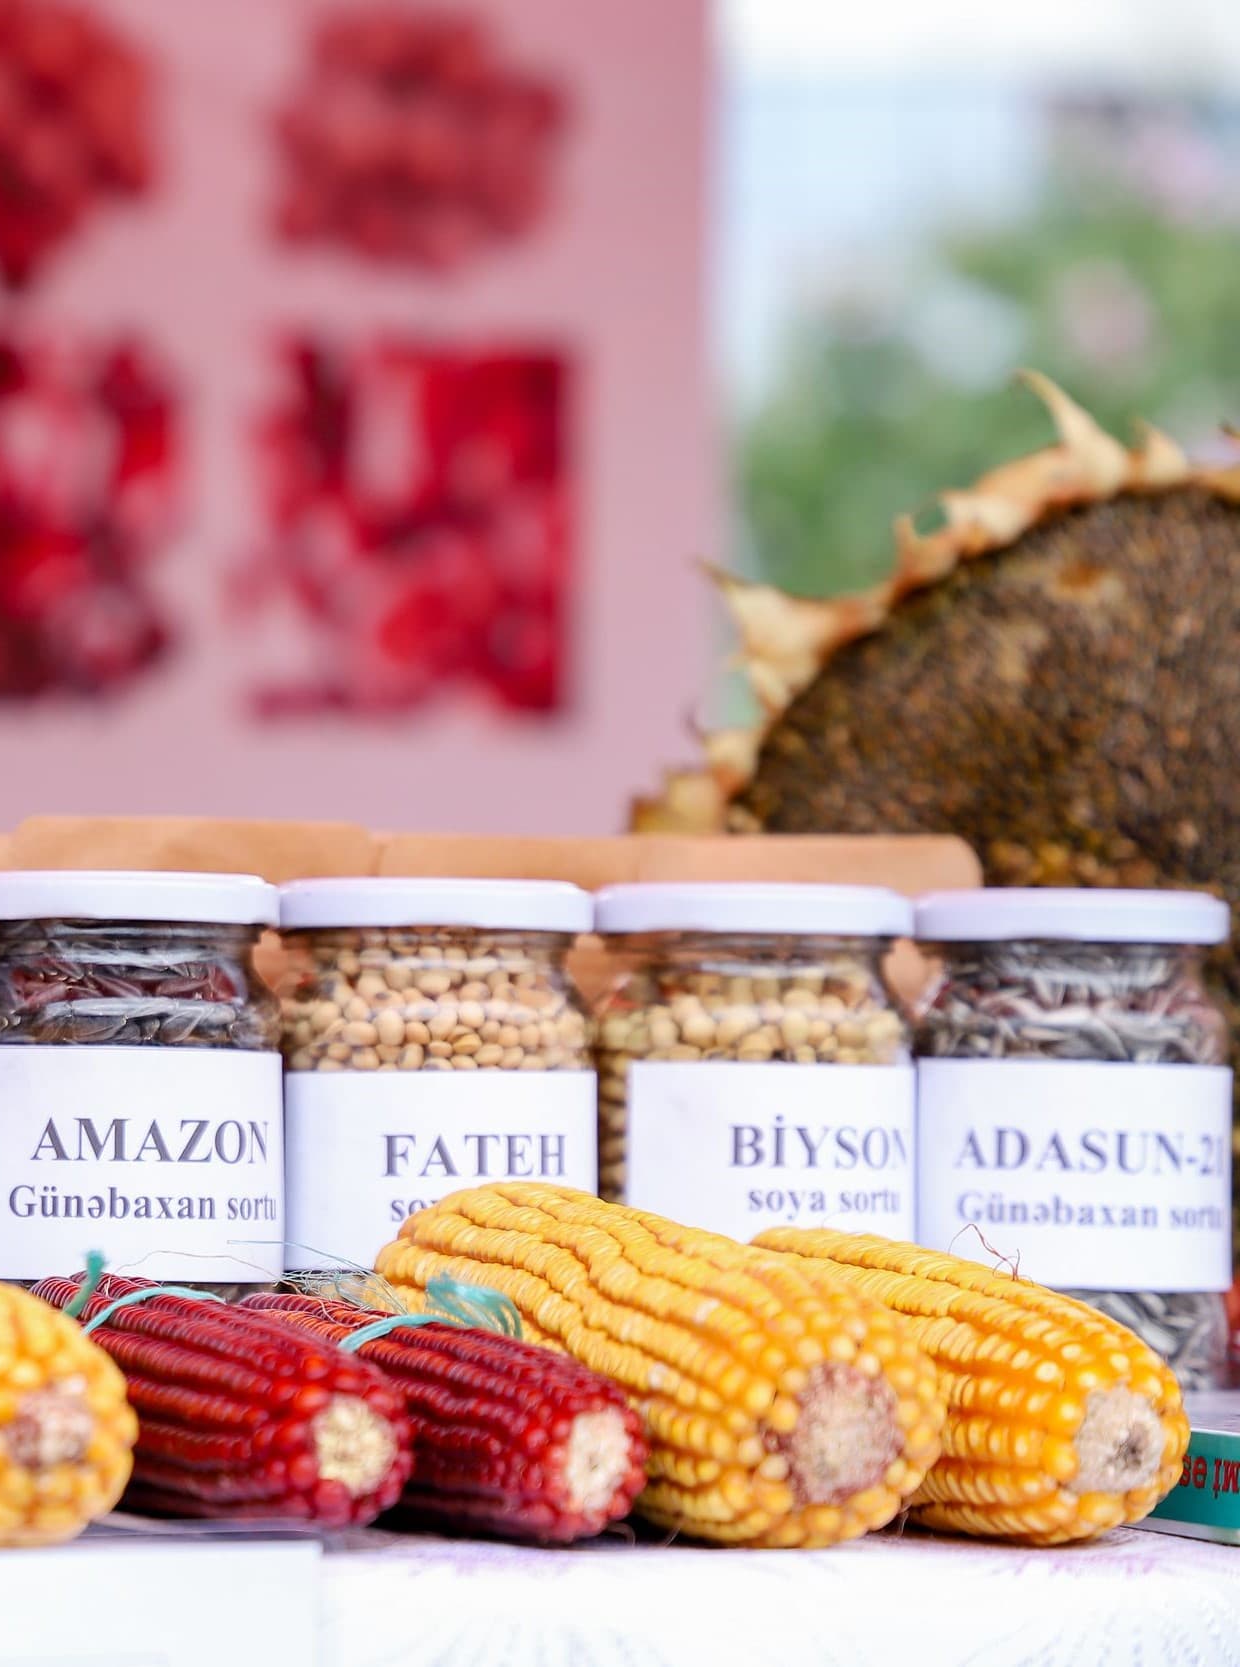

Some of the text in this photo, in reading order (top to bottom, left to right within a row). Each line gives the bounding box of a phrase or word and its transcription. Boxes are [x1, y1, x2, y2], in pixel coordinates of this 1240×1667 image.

[29, 1116, 269, 1165] AMAZON
[381, 1133, 568, 1178] FATEH
[9, 1184, 278, 1221] Günəbaxan sortu
[748, 1188, 825, 1221] soya
[956, 1191, 1158, 1227] Günəbaxan
